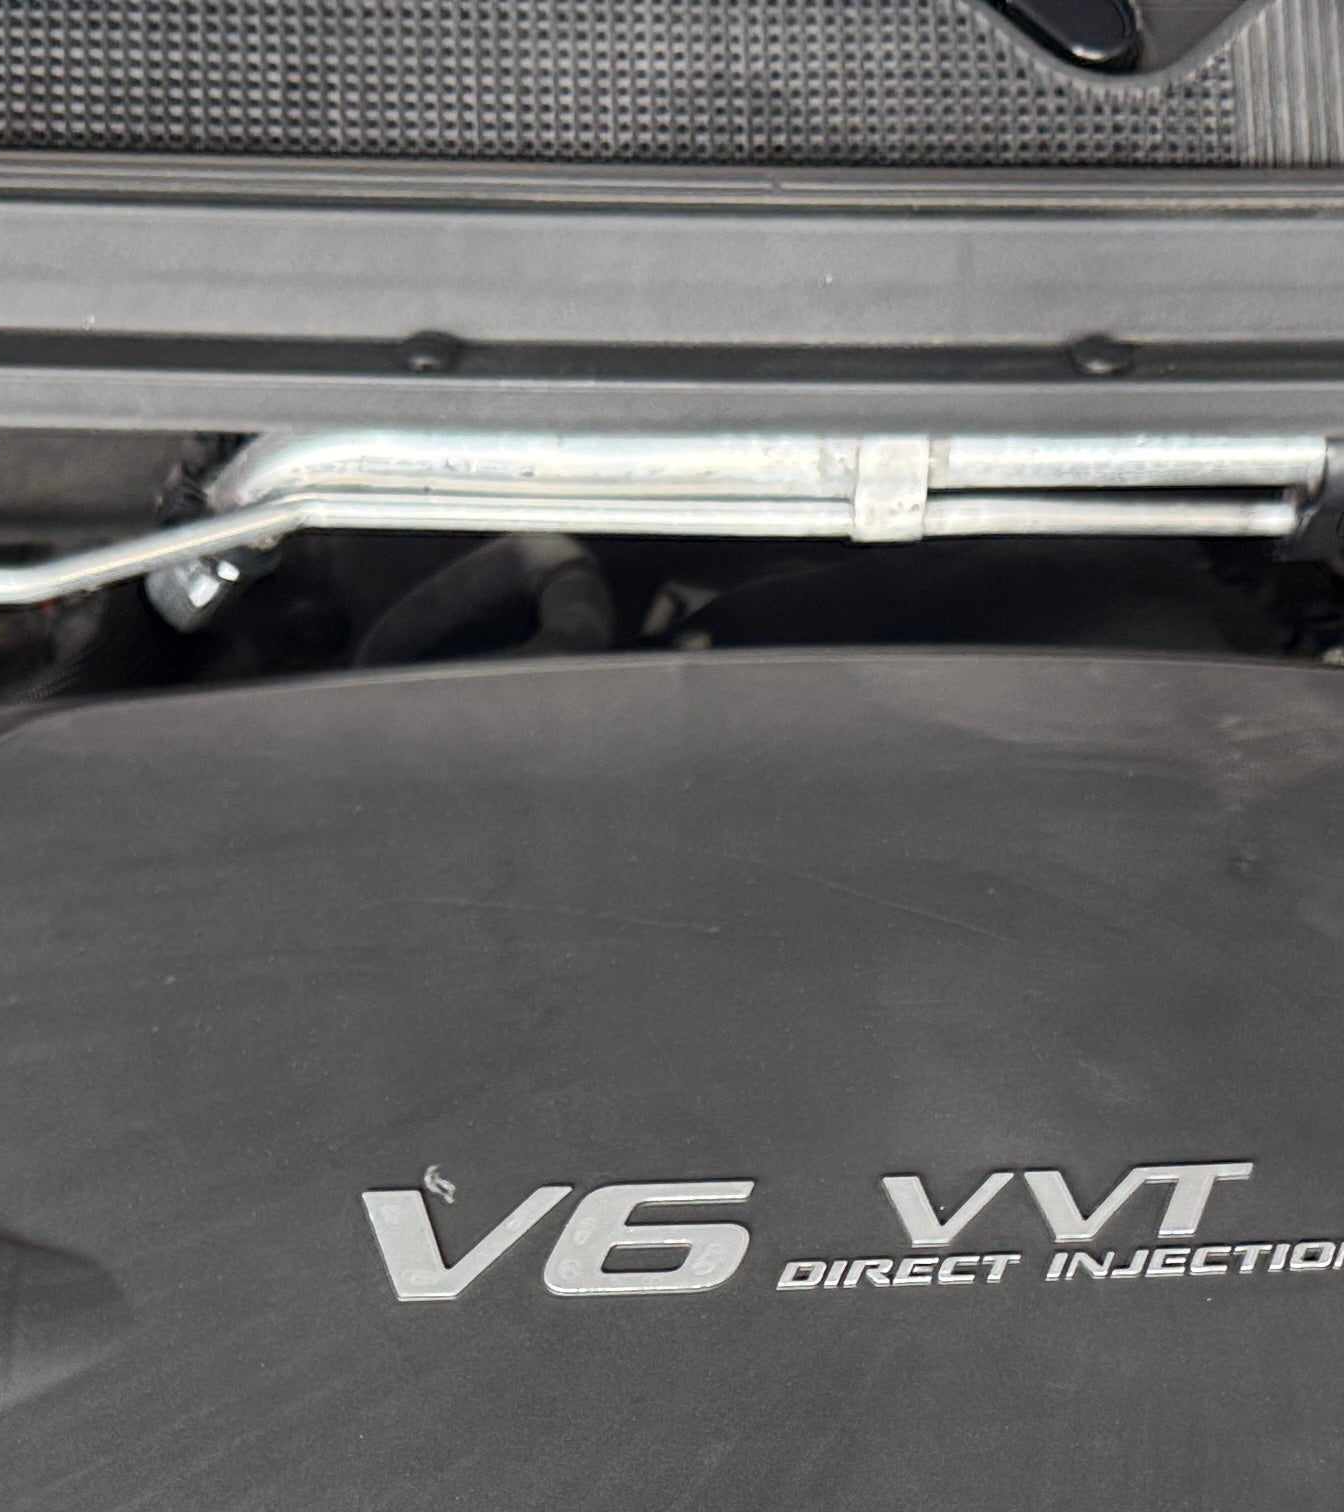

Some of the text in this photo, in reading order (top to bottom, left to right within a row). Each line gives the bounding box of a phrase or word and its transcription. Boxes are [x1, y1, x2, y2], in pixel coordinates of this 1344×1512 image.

[362, 1180, 755, 1301] V6
[882, 1162, 1254, 1247] VVT
[776, 1253, 1021, 1290] DIRECT
